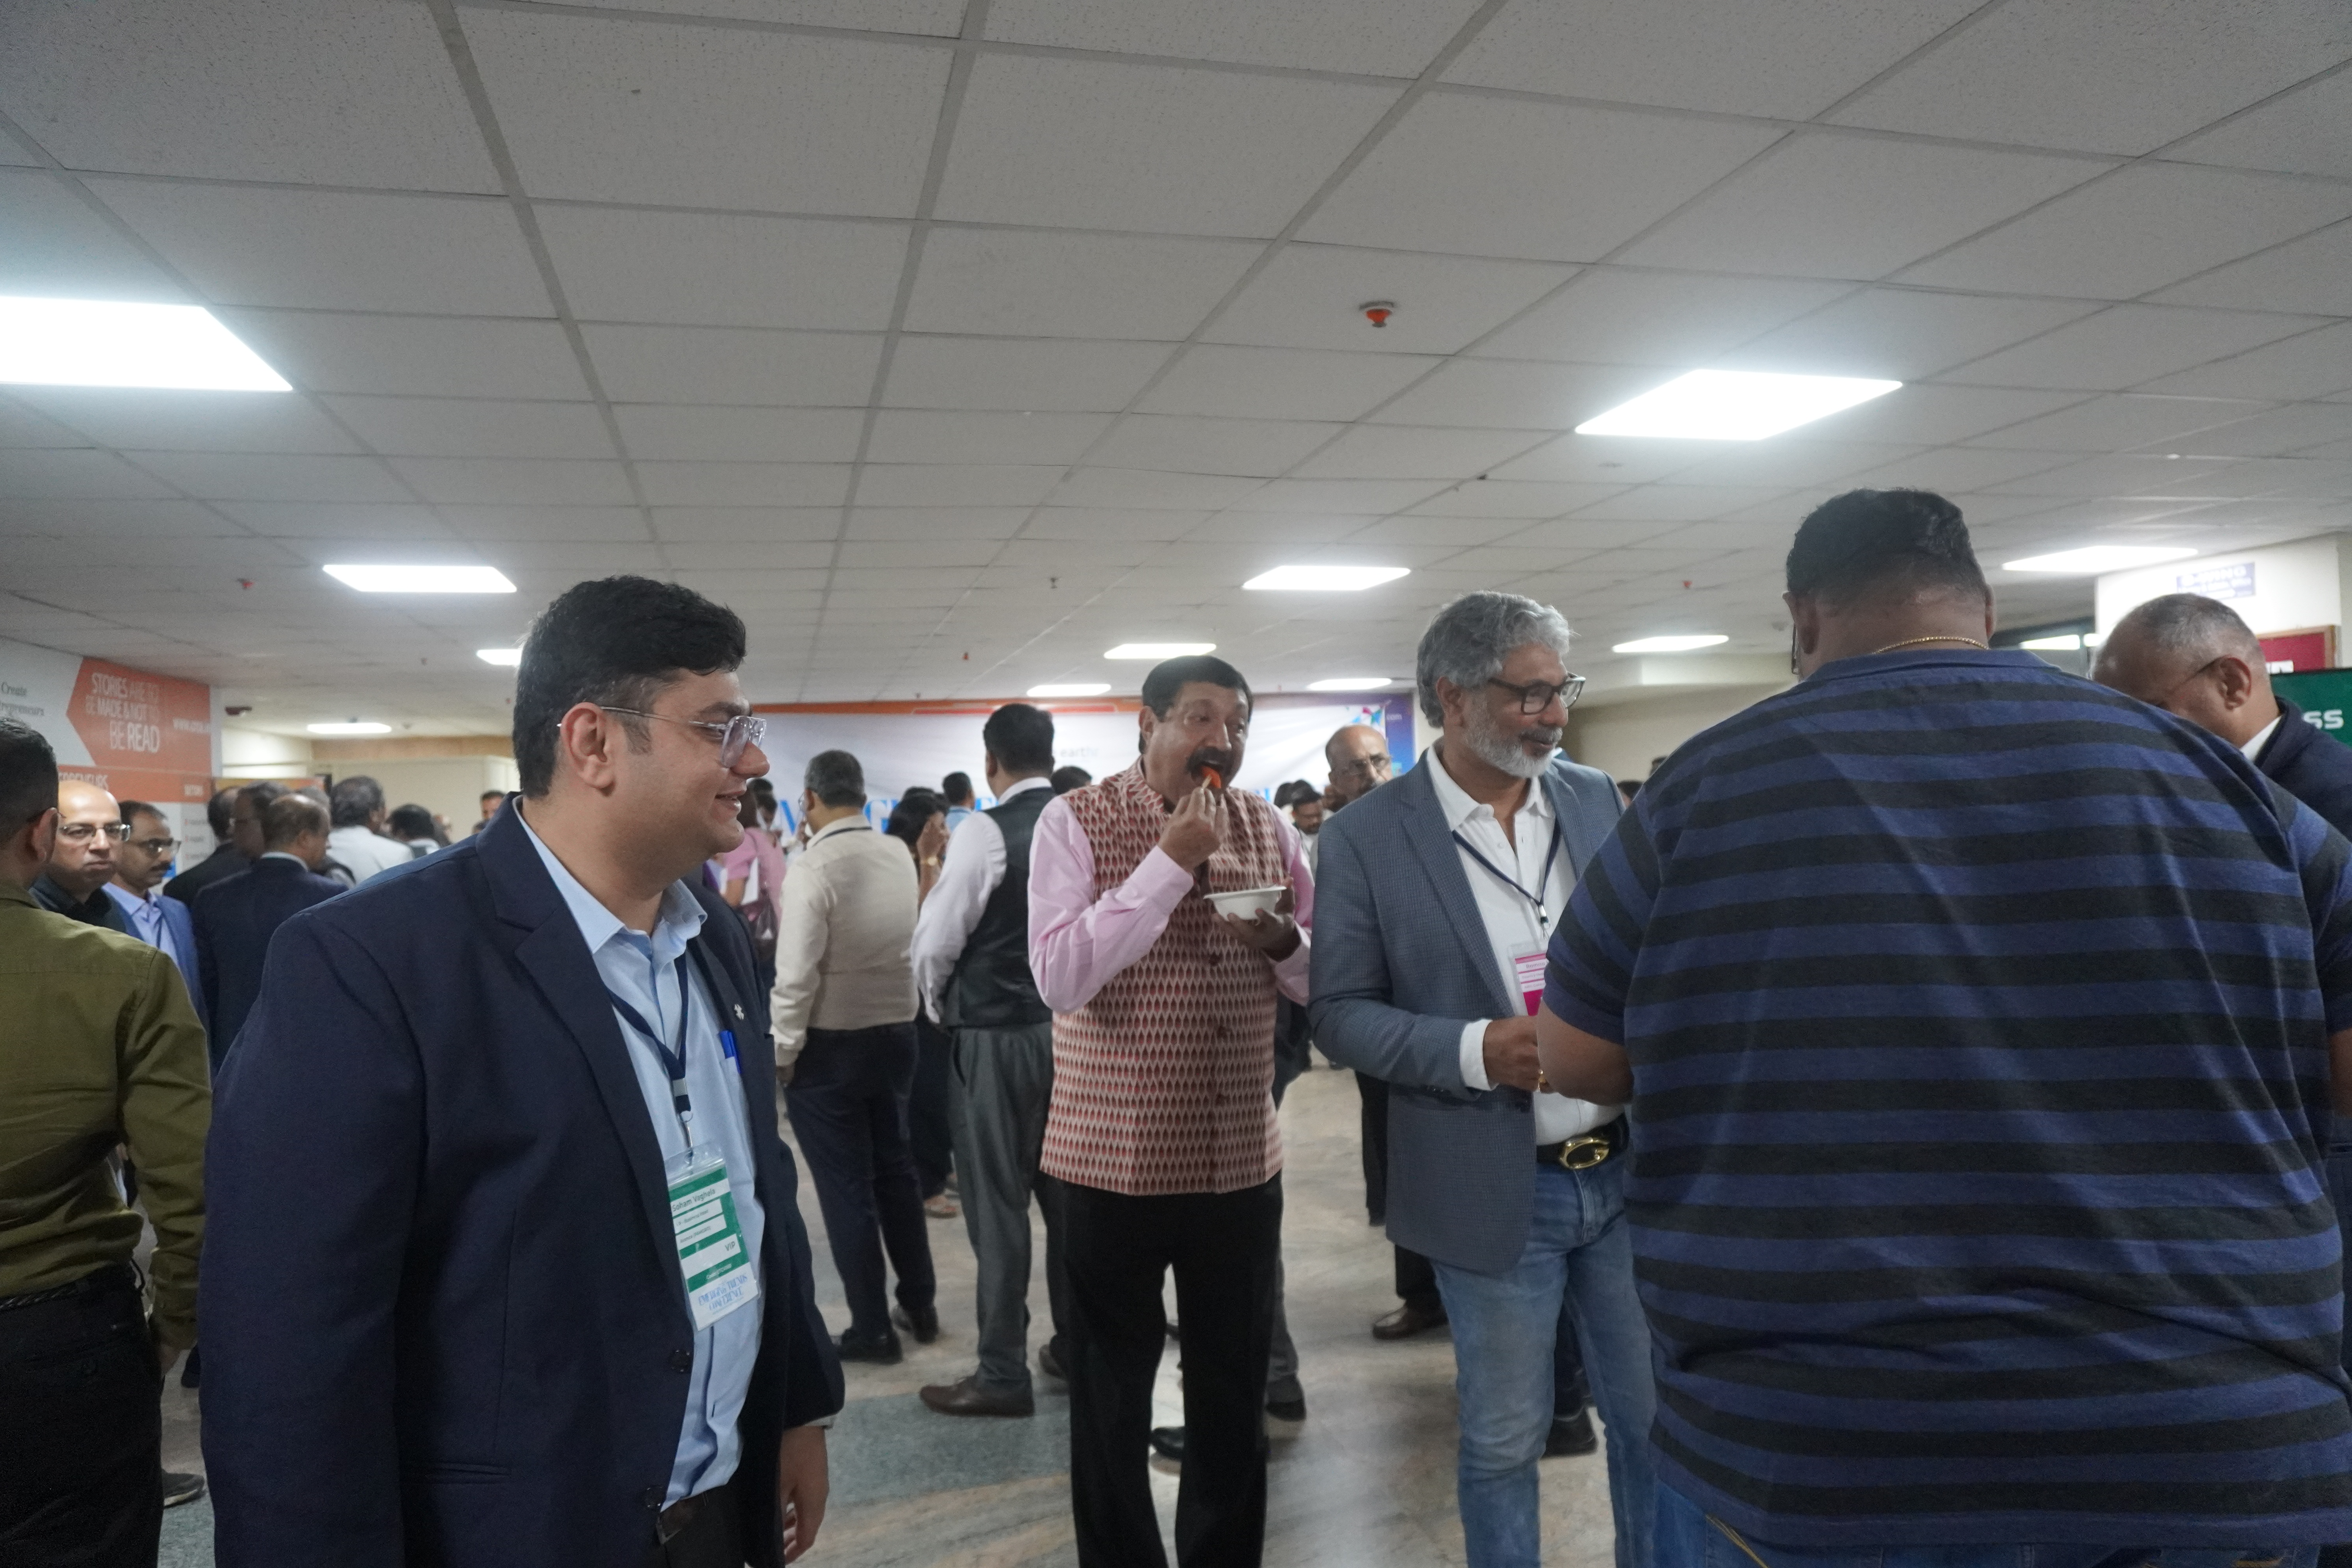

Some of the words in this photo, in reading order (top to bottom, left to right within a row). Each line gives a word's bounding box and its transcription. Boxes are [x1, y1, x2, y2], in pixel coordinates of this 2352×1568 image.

[92, 672, 128, 698] STORIES
[110, 720, 125, 750] BE
[127, 722, 160, 753] READ
[672, 1200, 692, 1212] Soham
[693, 1189, 715, 1201] Vaghela
[725, 1241, 735, 1251] VIP
